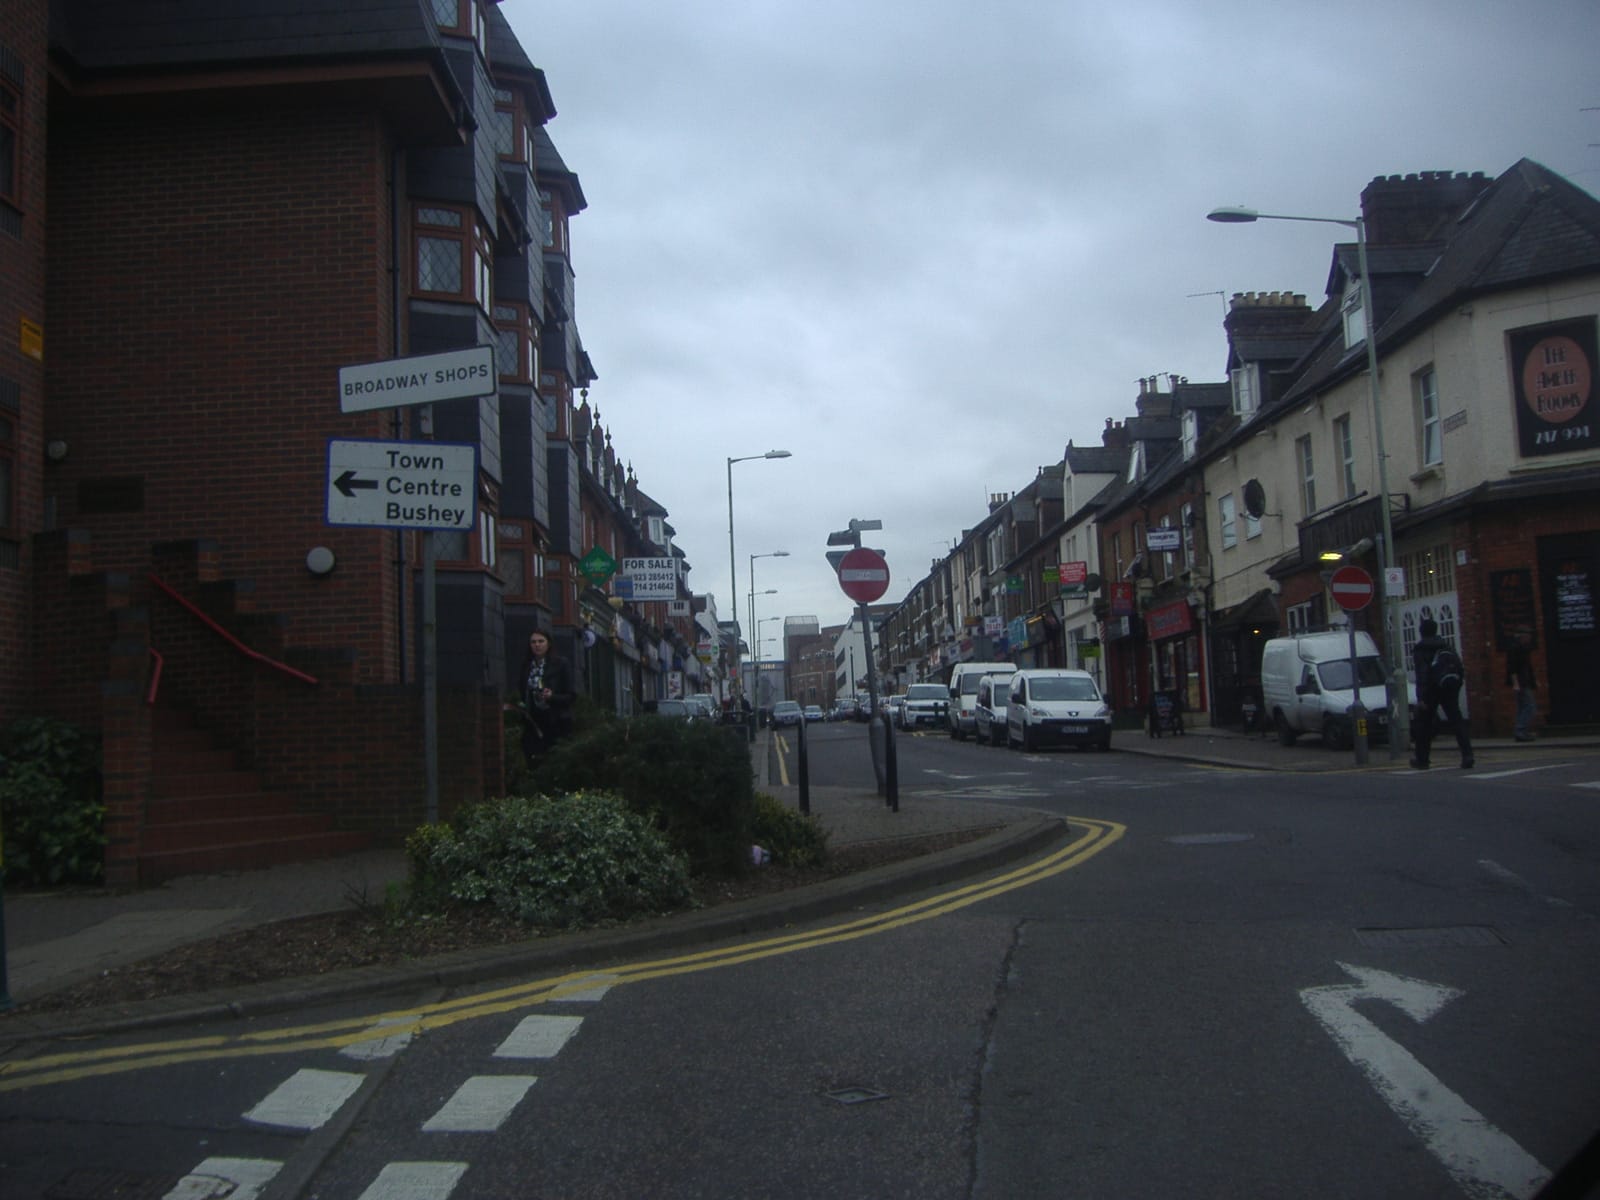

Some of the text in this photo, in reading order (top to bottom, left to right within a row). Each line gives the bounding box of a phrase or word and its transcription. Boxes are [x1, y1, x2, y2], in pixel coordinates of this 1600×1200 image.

[344, 364, 488, 396] BROADWAY SHOPS
[1537, 391, 1580, 414] ROOMS
[386, 450, 444, 470] Town
[386, 476, 462, 497] Centre
[386, 502, 465, 526] Bushey
[624, 560, 645, 570] FOR
[648, 559, 674, 569] SALE
